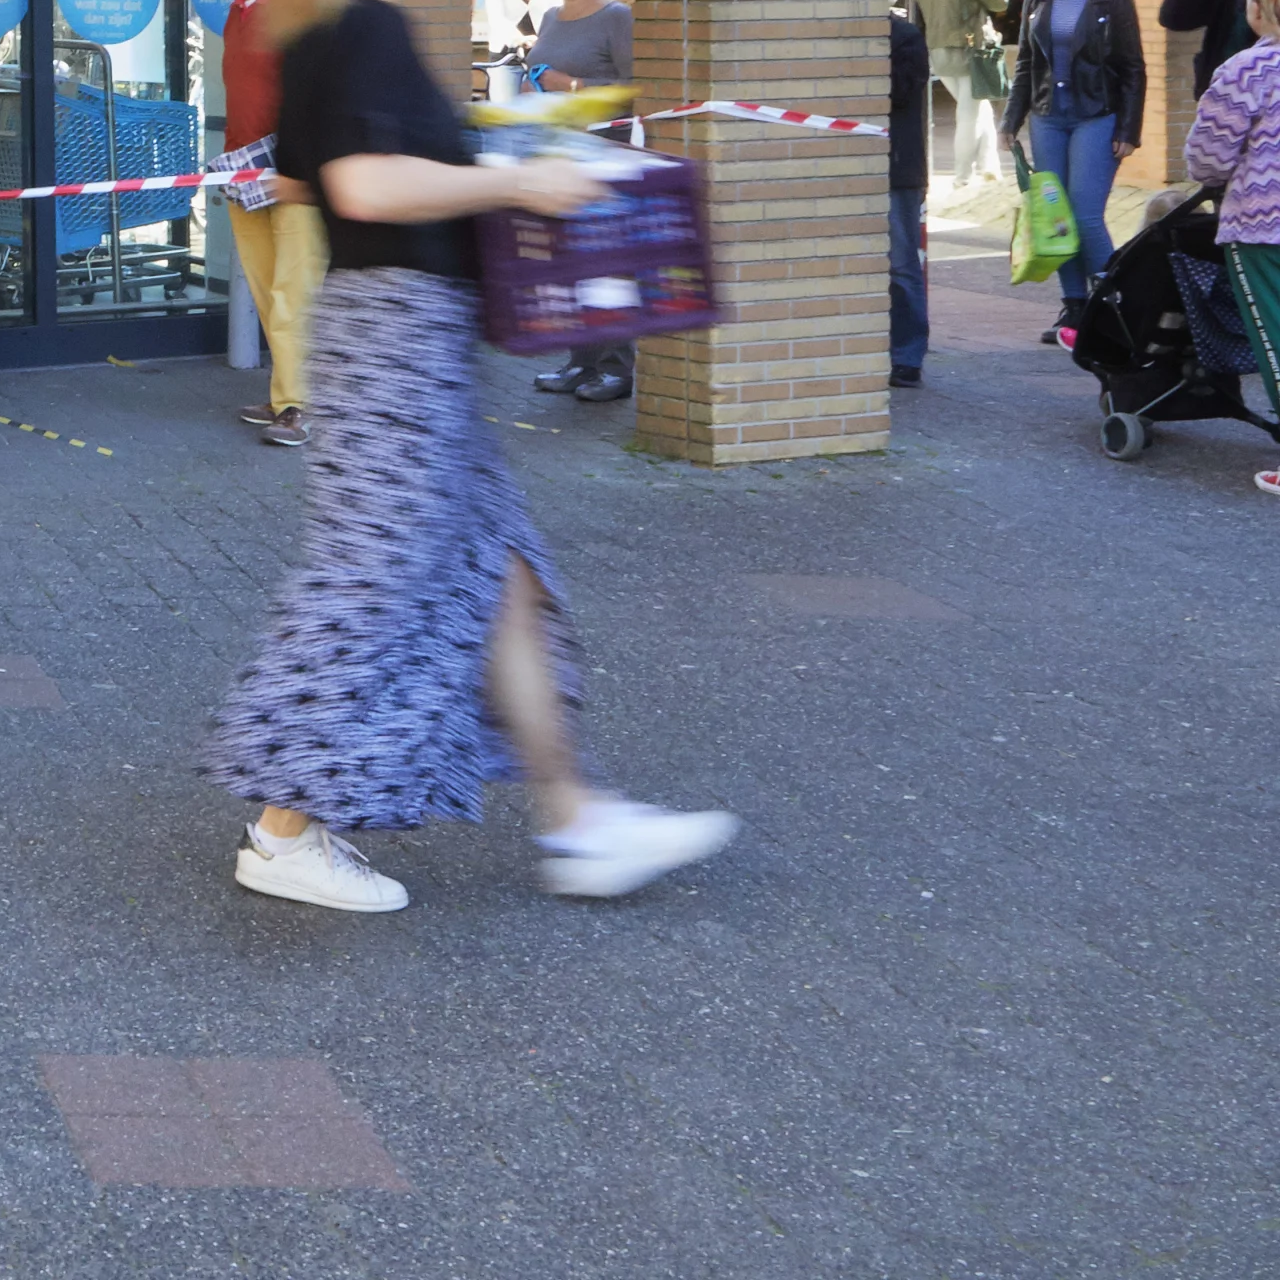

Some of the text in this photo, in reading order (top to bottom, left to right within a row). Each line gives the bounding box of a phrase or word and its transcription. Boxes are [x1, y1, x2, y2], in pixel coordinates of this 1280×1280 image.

[74, 0, 142, 11] wat zou dat
[84, 12, 133, 28] dan zijn?
